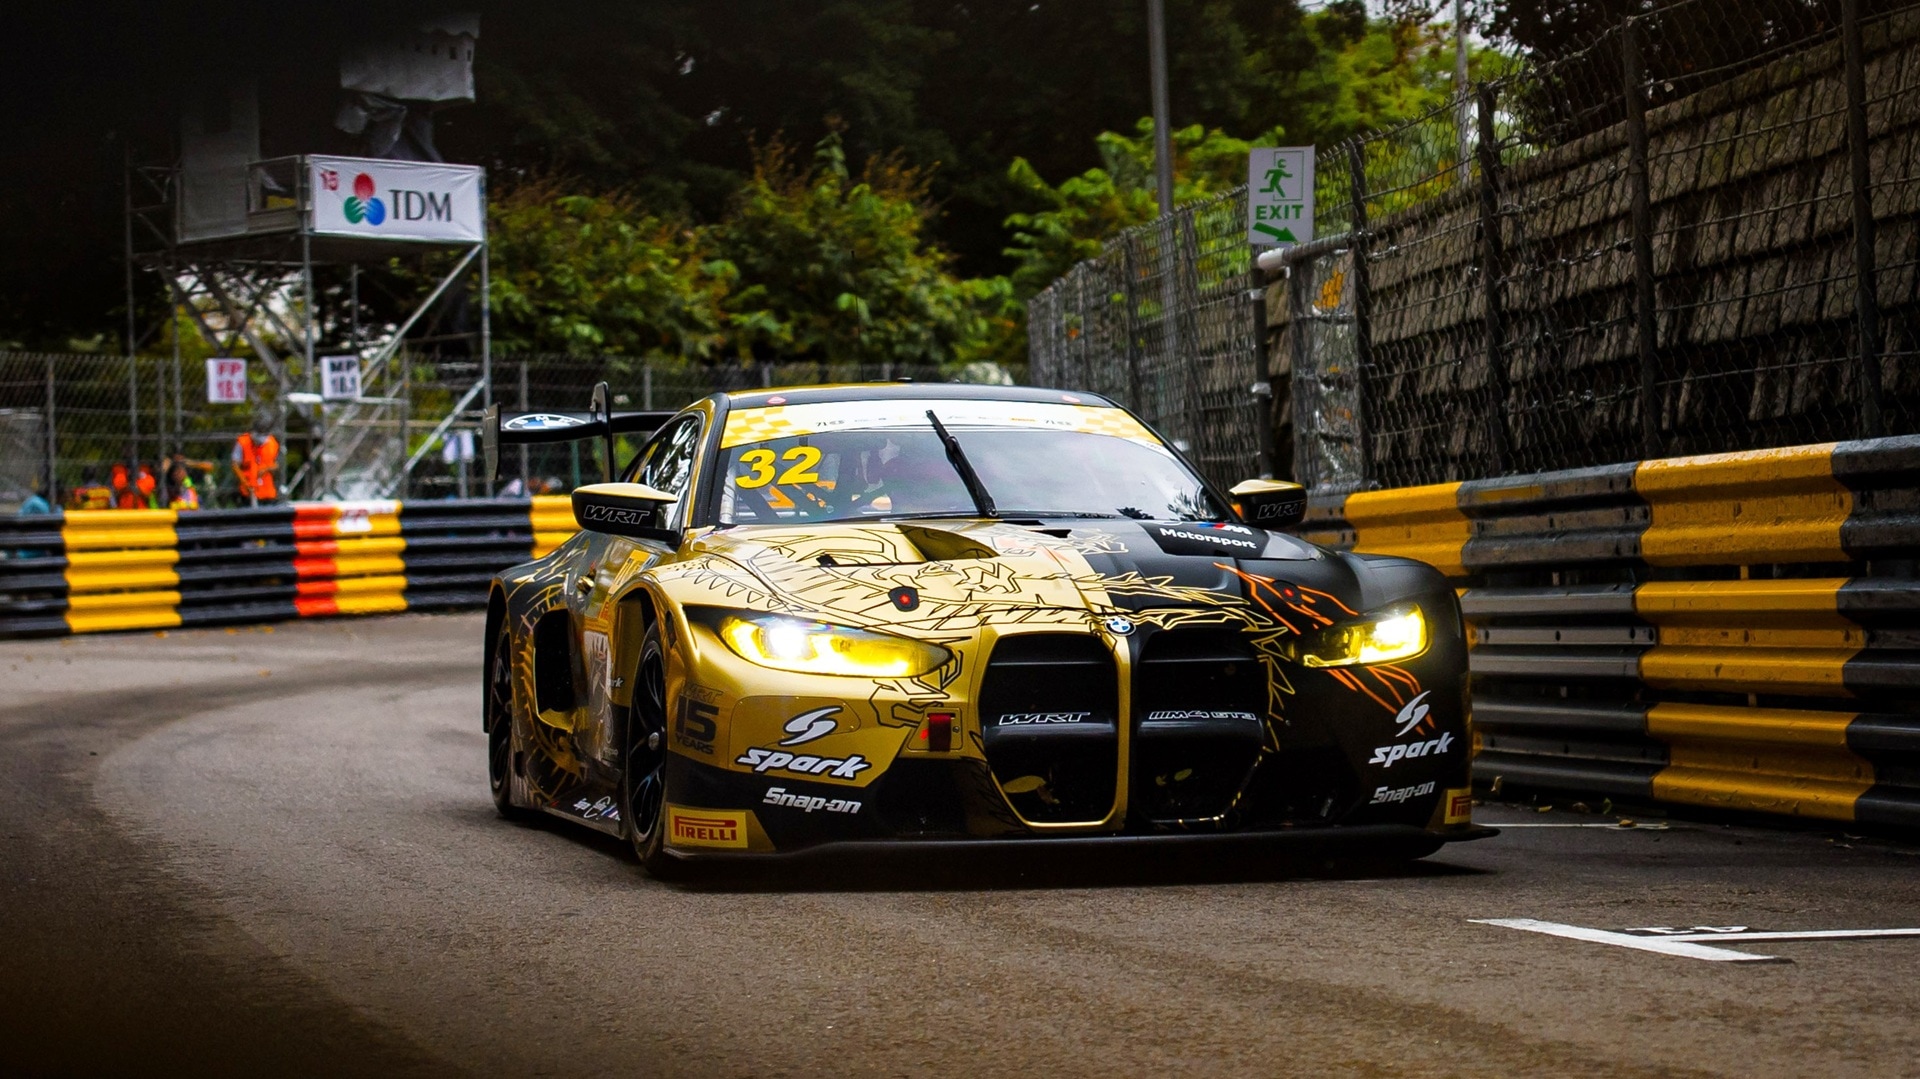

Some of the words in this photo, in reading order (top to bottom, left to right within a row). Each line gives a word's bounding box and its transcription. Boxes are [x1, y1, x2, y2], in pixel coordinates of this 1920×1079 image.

[388, 189, 453, 222] TDM
[1256, 204, 1304, 220] EXIT
[735, 446, 822, 489] 32
[583, 504, 651, 525] WRT
[1159, 527, 1257, 549] Motorsport
[676, 695, 720, 742] 15
[999, 712, 1091, 725] WRT
[676, 731, 715, 755] YEARS
[1368, 731, 1455, 768] spark
[736, 748, 869, 778] spark
[762, 787, 861, 814] Snap-on
[1369, 781, 1436, 805] Snap-on
[674, 815, 738, 841] PIRELLI
